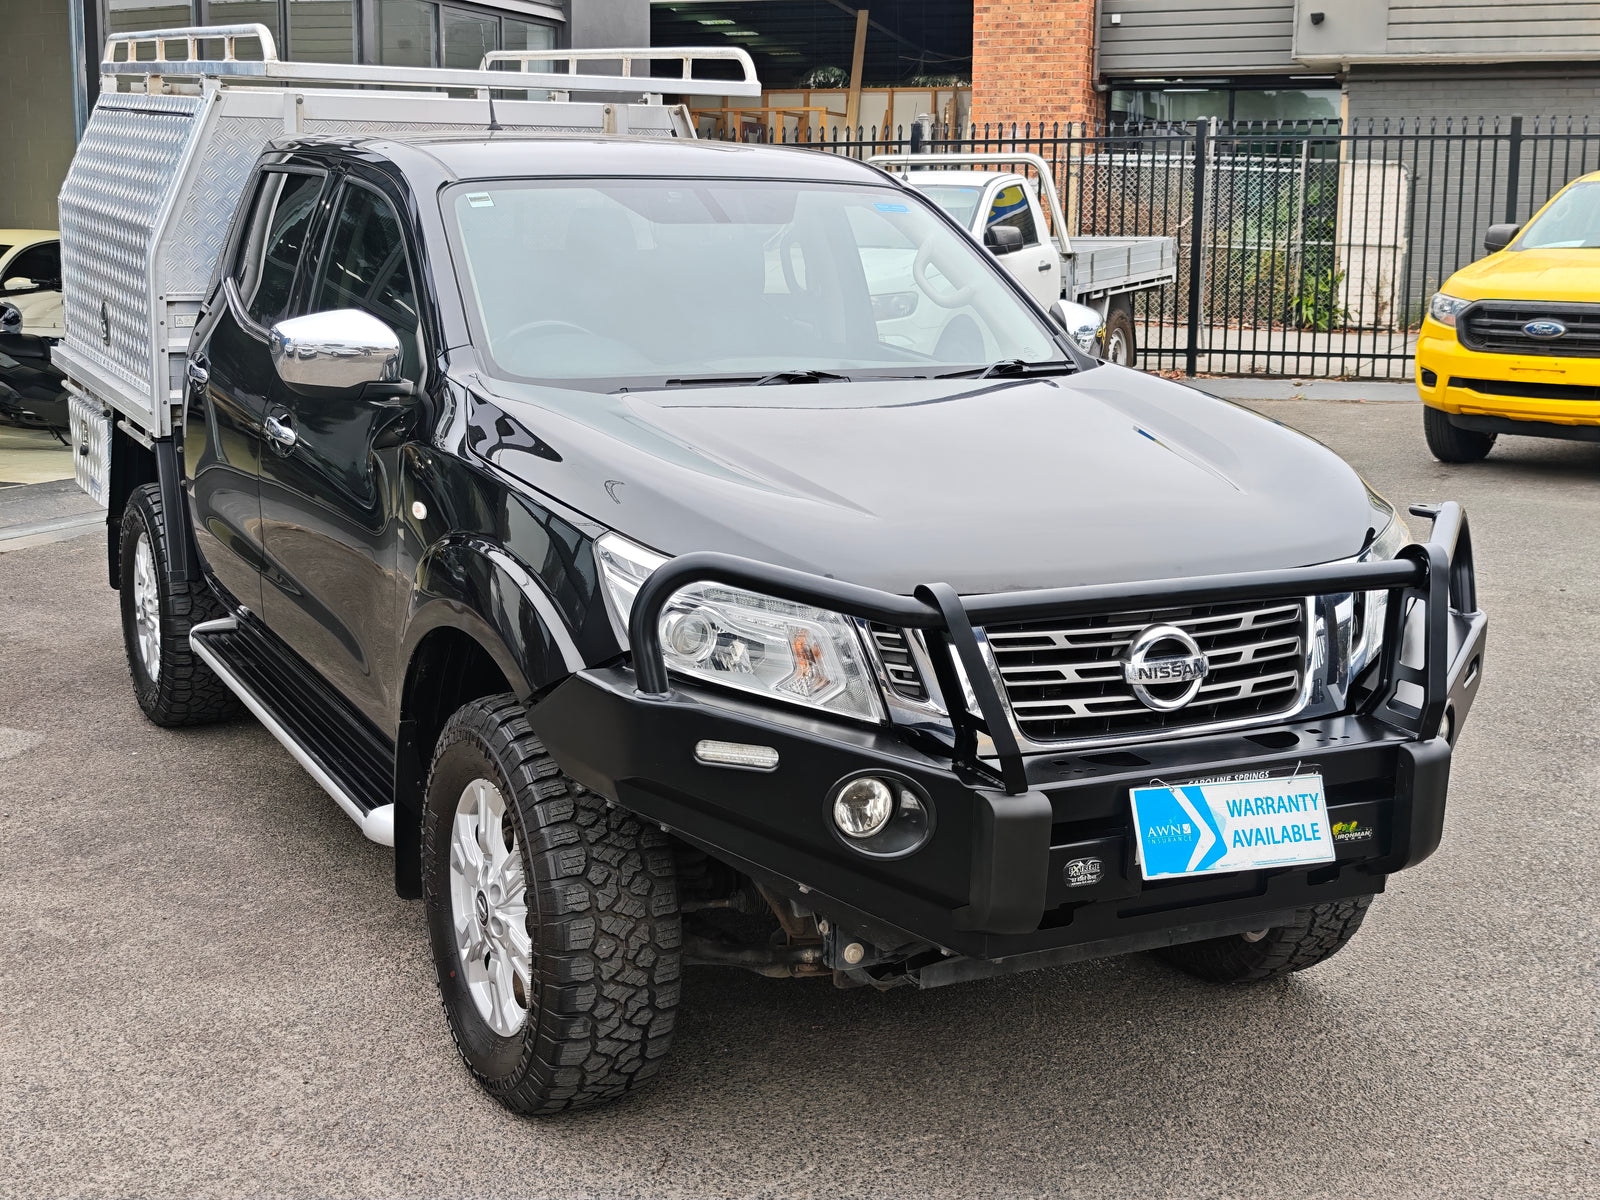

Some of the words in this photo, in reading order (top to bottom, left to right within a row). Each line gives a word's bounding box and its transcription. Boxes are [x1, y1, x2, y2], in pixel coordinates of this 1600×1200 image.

[1531, 323, 1555, 335] Ford
[1138, 662, 1204, 680] NISSAN
[1234, 771, 1270, 782] SPRINGS
[1226, 793, 1319, 818] WARRANTY
[1148, 824, 1181, 838] AWN
[1233, 822, 1322, 848] AVAILABLE
[1336, 830, 1371, 840] IRONMAN
[1148, 836, 1192, 845] INSURANCE
